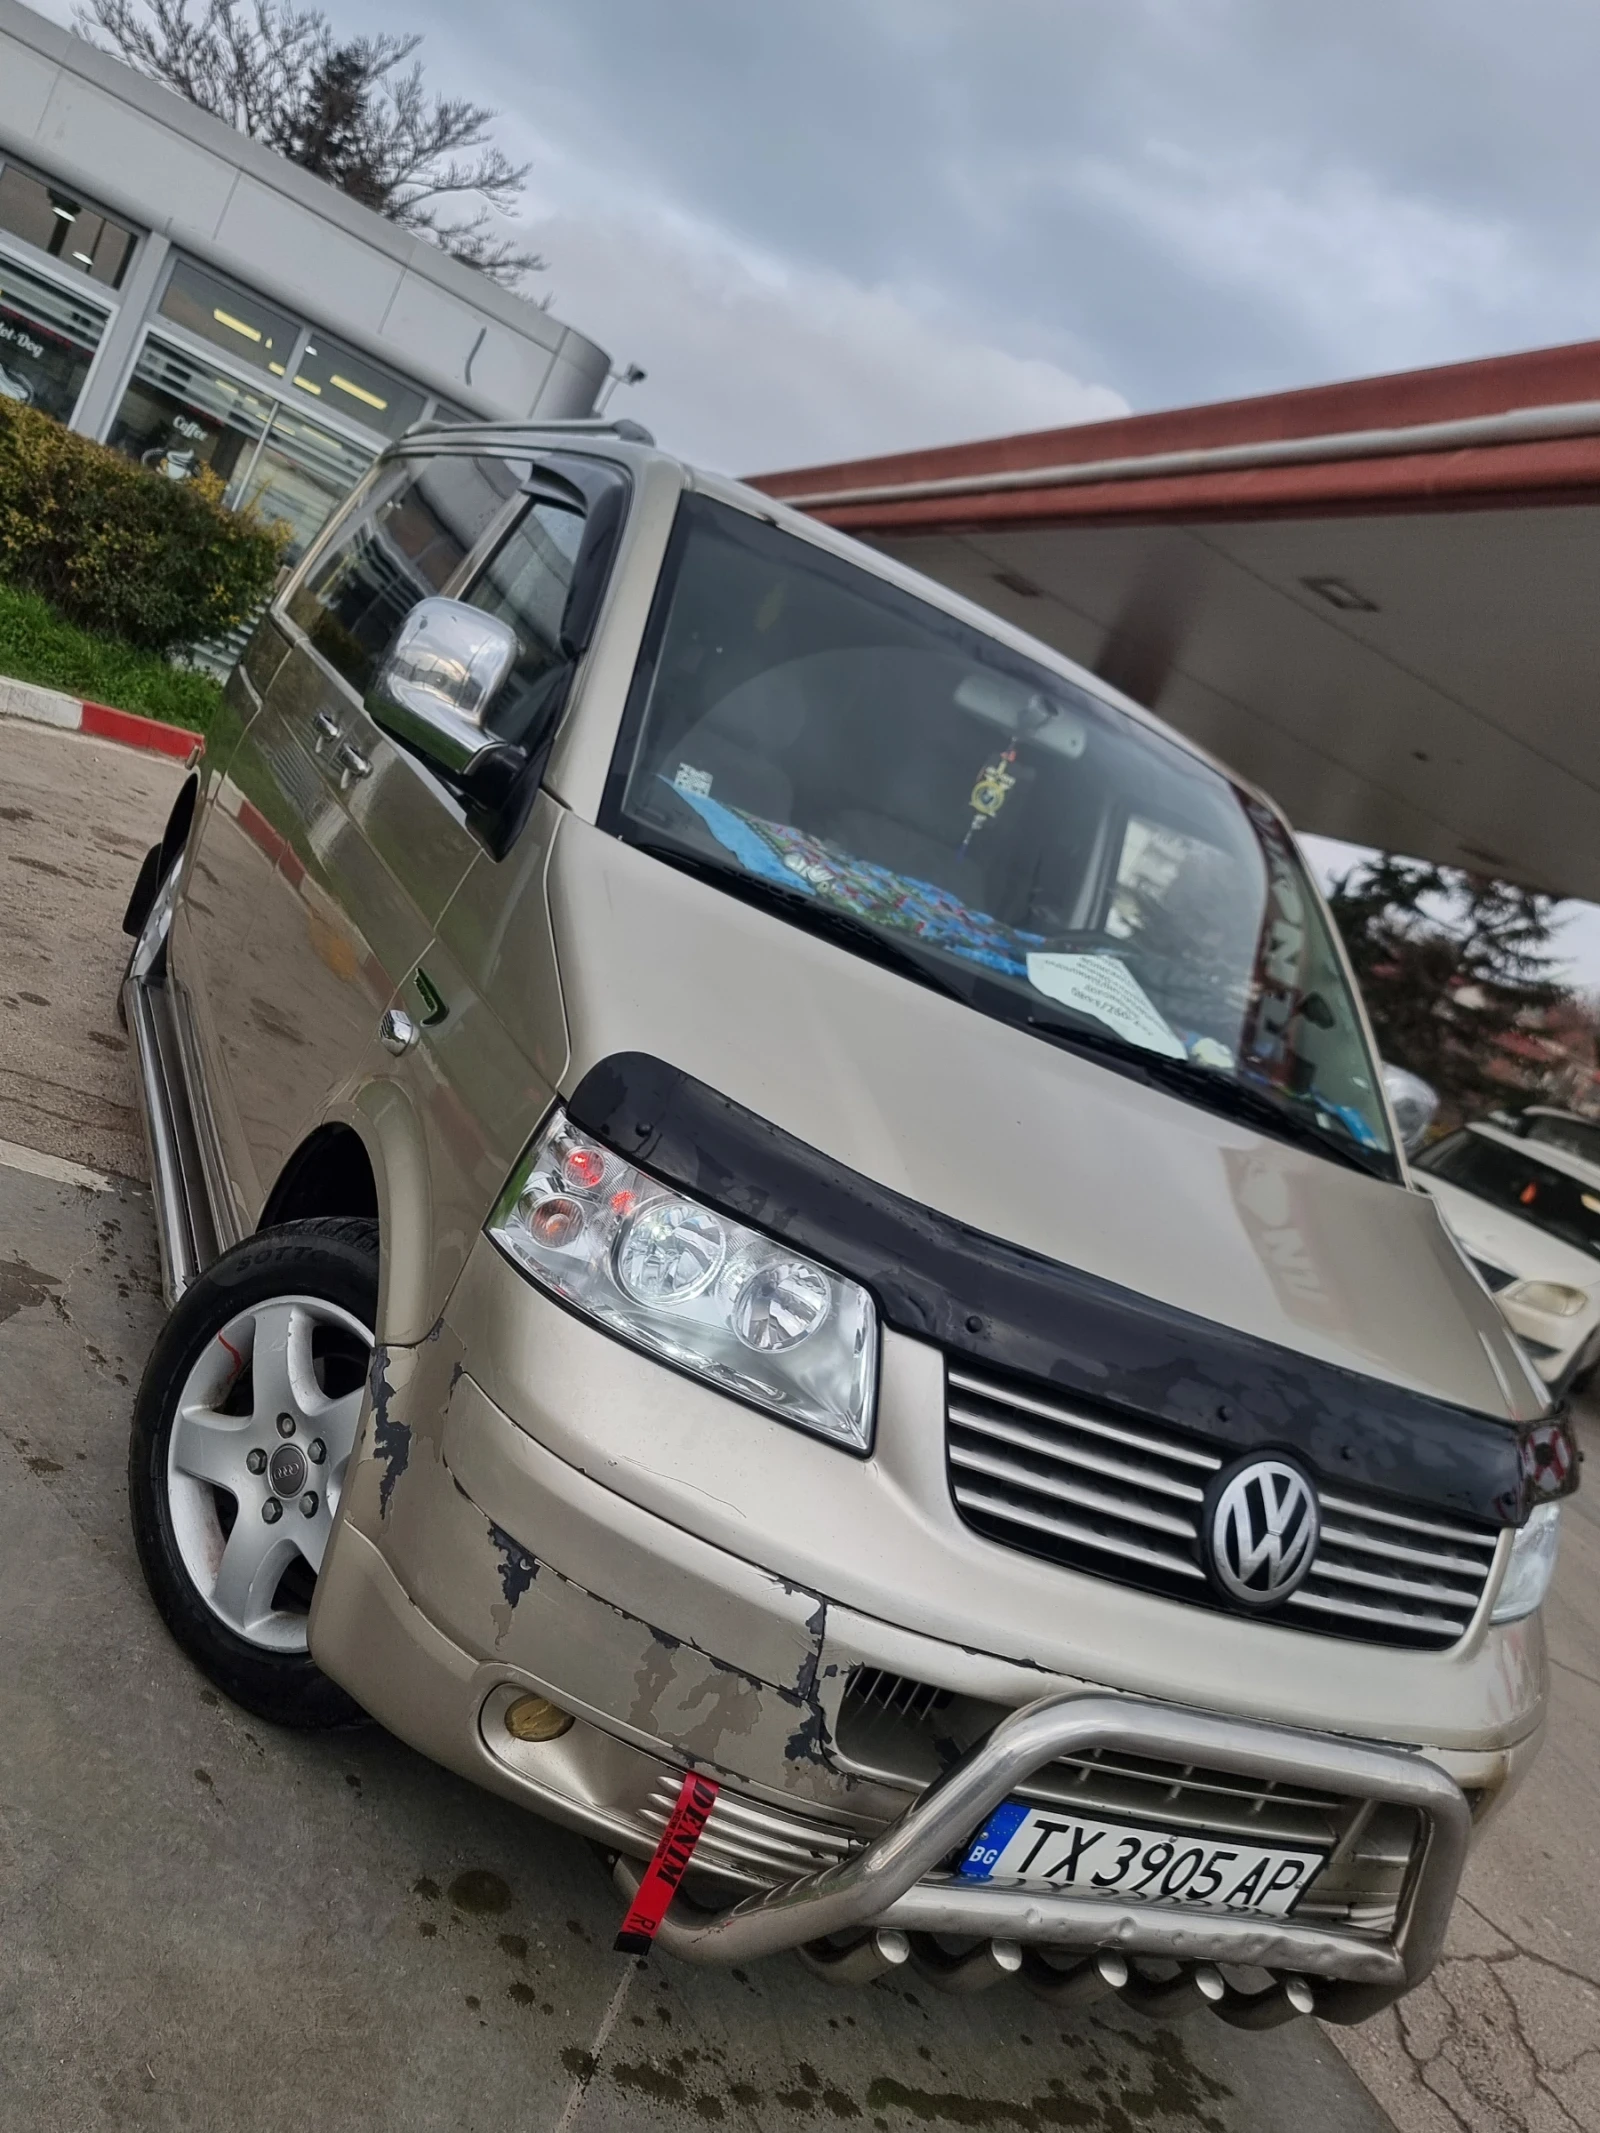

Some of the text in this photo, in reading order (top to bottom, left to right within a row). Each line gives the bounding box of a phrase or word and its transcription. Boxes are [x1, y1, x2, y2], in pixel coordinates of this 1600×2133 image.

[0, 321, 44, 358] ot-Dog
[173, 414, 208, 441] Coffee
[1214, 1461, 1318, 1602] VW
[656, 1779, 716, 1888] DENIM
[968, 1845, 998, 1865] BG
[1017, 1819, 1305, 1906] TX 3905 AP
